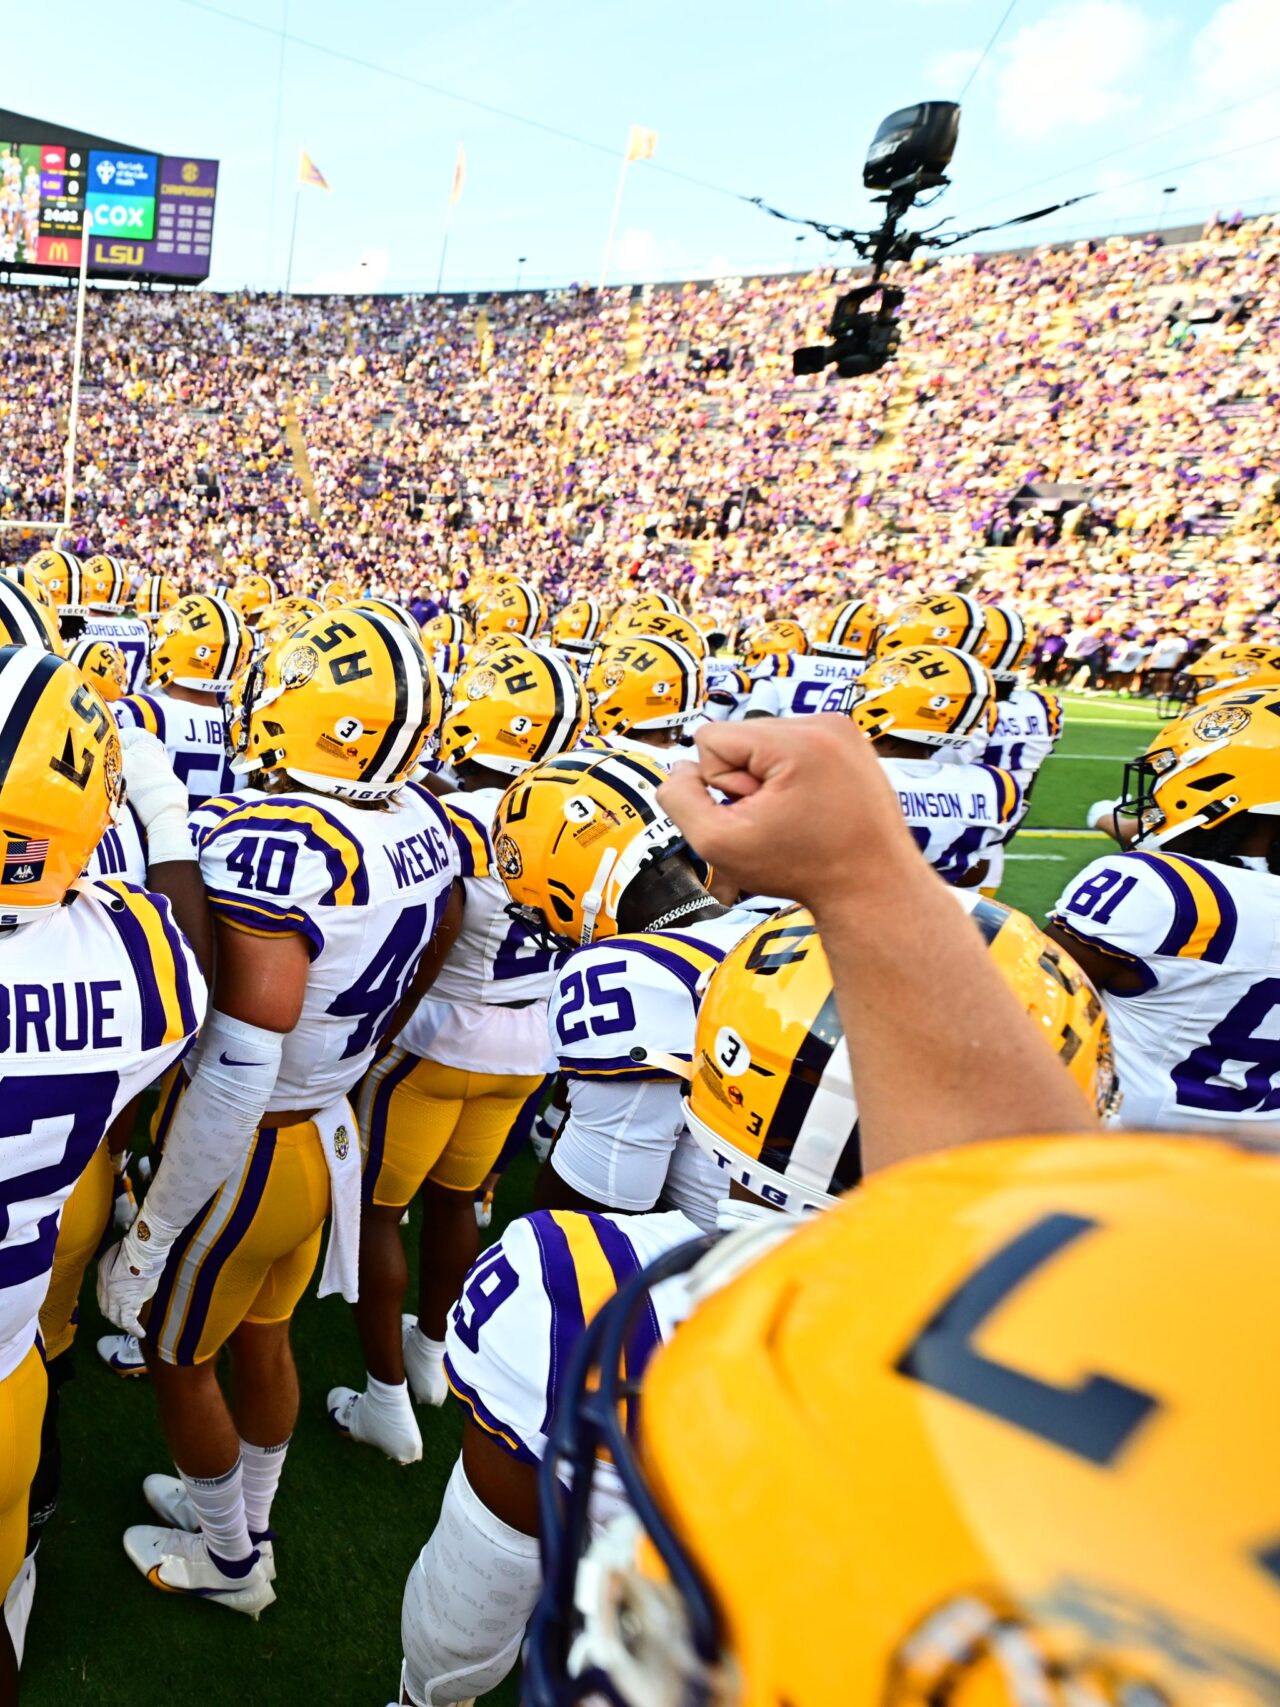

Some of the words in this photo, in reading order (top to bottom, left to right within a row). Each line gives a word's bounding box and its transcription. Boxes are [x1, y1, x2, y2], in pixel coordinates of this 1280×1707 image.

[94, 204, 144, 228] COX
[95, 244, 144, 265] LSU
[198, 646, 206, 657] 3
[658, 682, 665, 693] 3
[934, 696, 945, 708] 3
[185, 718, 201, 743] J.
[340, 720, 357, 738] 3
[515, 718, 527, 731] 3
[528, 744, 536, 754] 2
[358, 758, 368, 769] 4
[570, 799, 589, 818] 3
[621, 804, 636, 819] 2
[898, 791, 963, 818] BINSON
[968, 794, 992, 820] JR.
[226, 837, 299, 895] 40
[383, 826, 449, 890] WEEKS
[1066, 869, 1138, 925] 81
[556, 960, 636, 1046] 25
[721, 1035, 740, 1067] 3
[746, 1111, 763, 1136] 3
